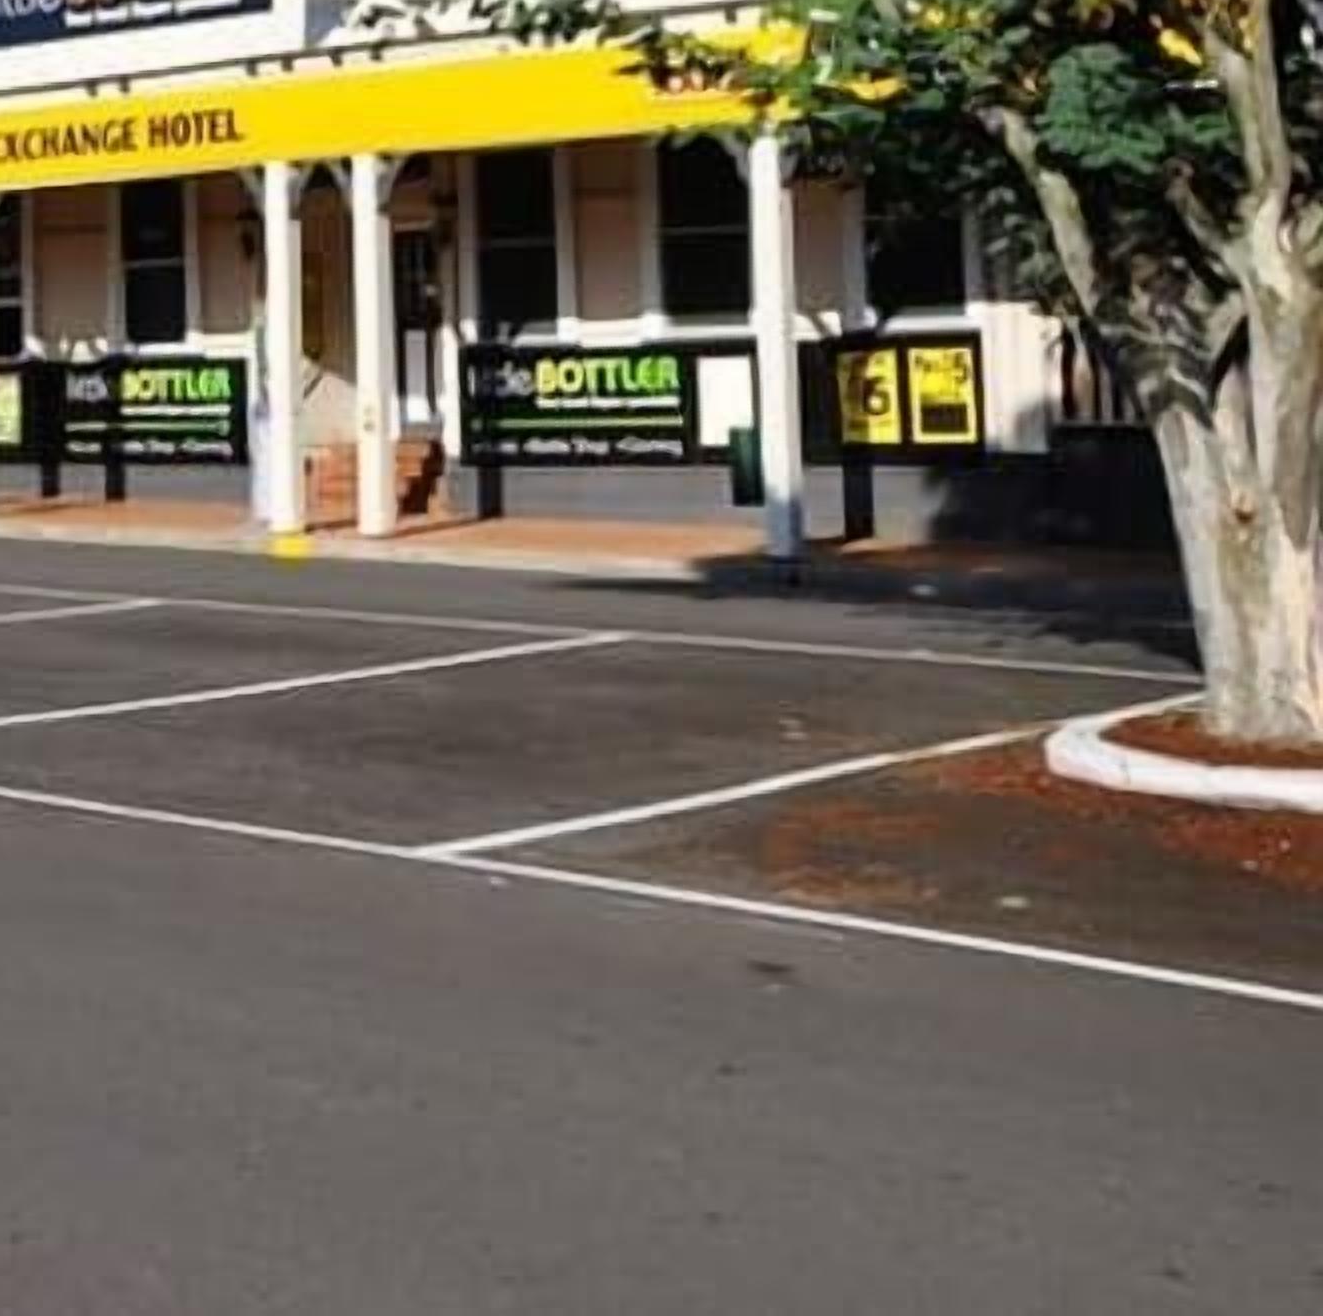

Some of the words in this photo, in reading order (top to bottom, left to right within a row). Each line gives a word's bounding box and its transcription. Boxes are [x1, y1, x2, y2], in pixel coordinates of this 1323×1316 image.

[148, 108, 244, 148] HOTEL
[121, 368, 231, 402] BOTTLER
[535, 355, 680, 395] BOTTLER
